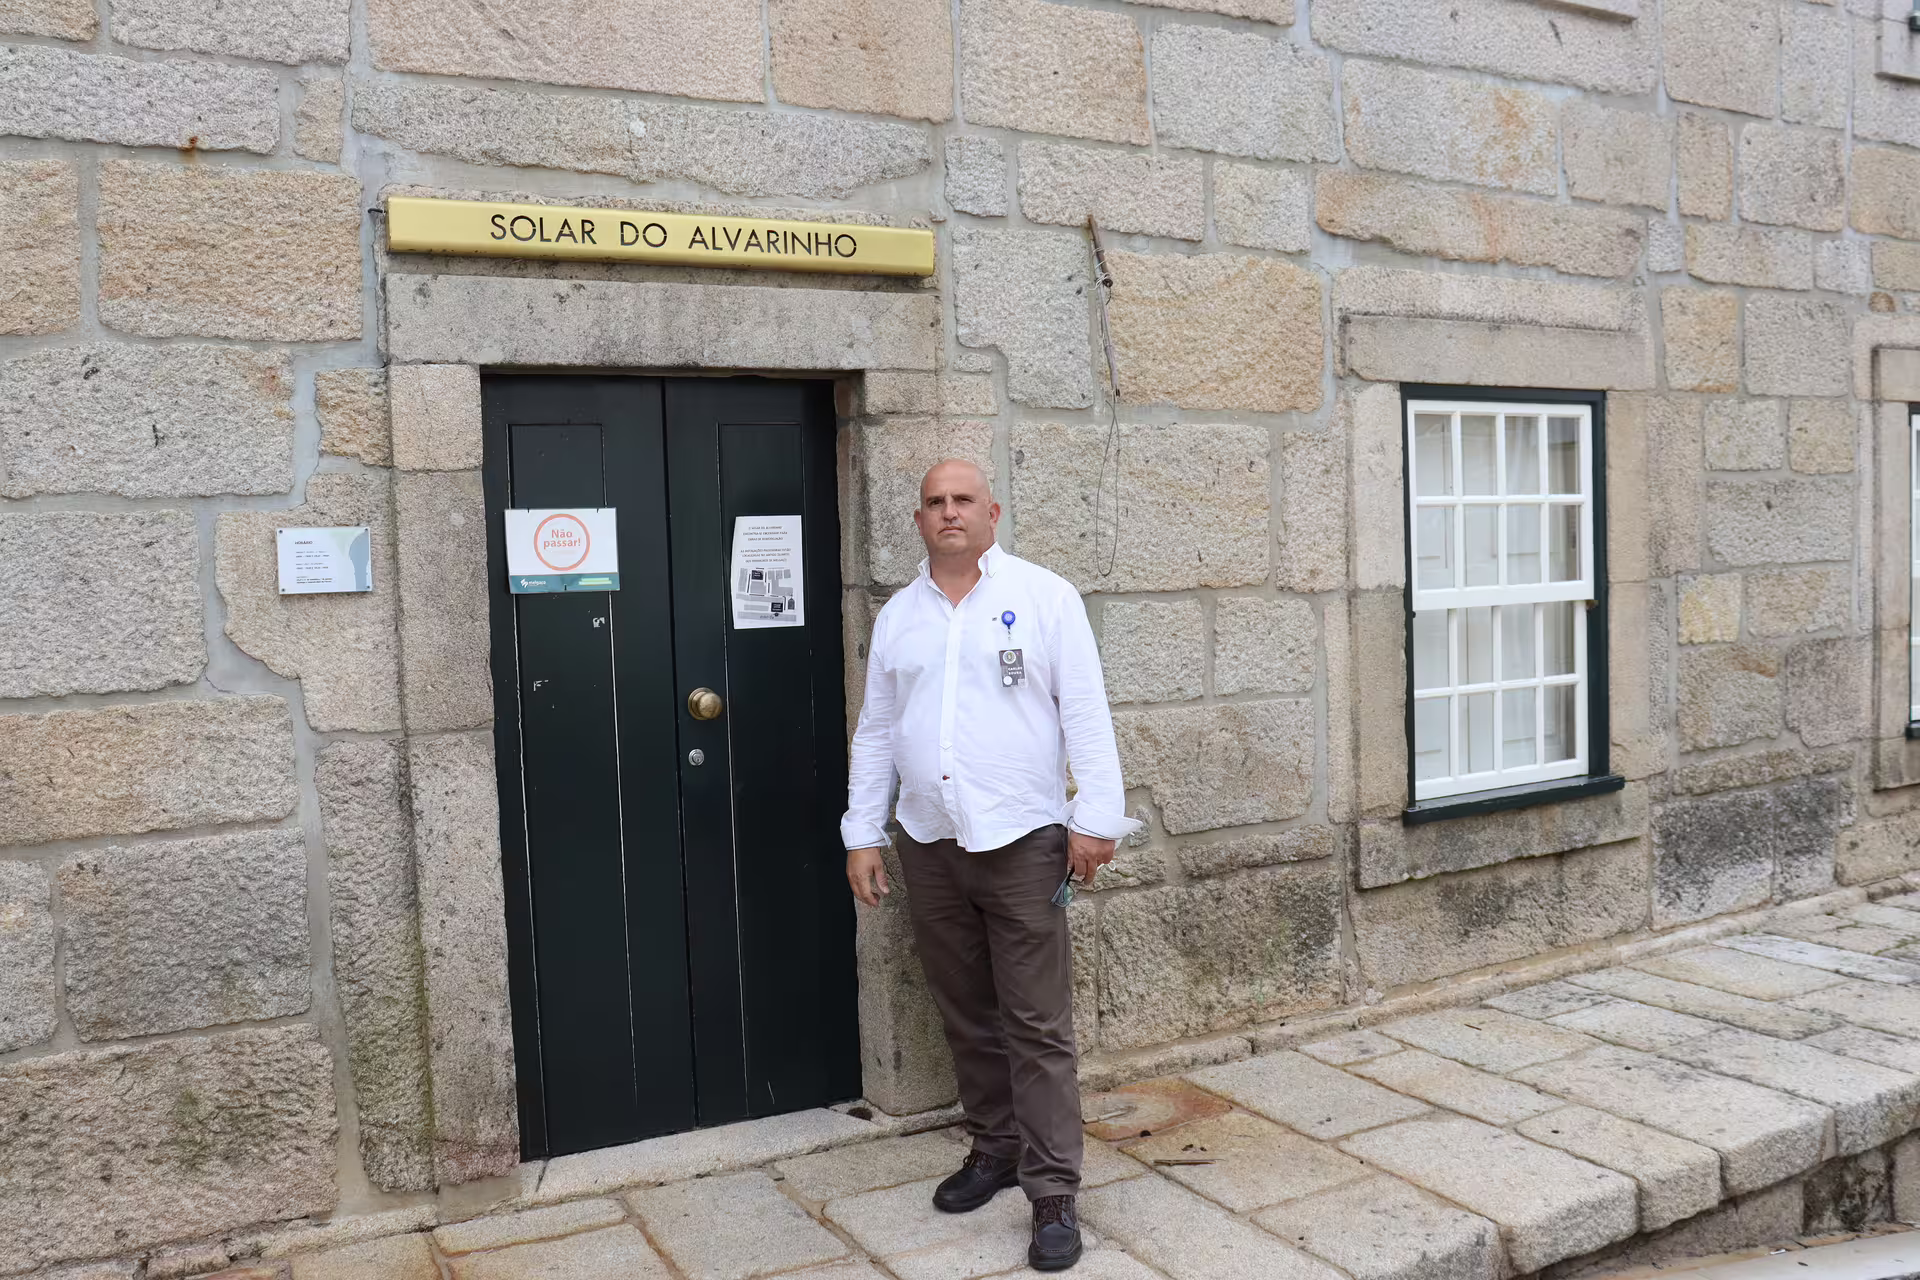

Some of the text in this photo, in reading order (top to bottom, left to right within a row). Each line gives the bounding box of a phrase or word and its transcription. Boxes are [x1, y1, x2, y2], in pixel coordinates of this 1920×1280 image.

[490, 214, 857, 258] SOLAR DO ALVARINHO
[551, 528, 573, 538] Não
[543, 537, 581, 550] passar!
